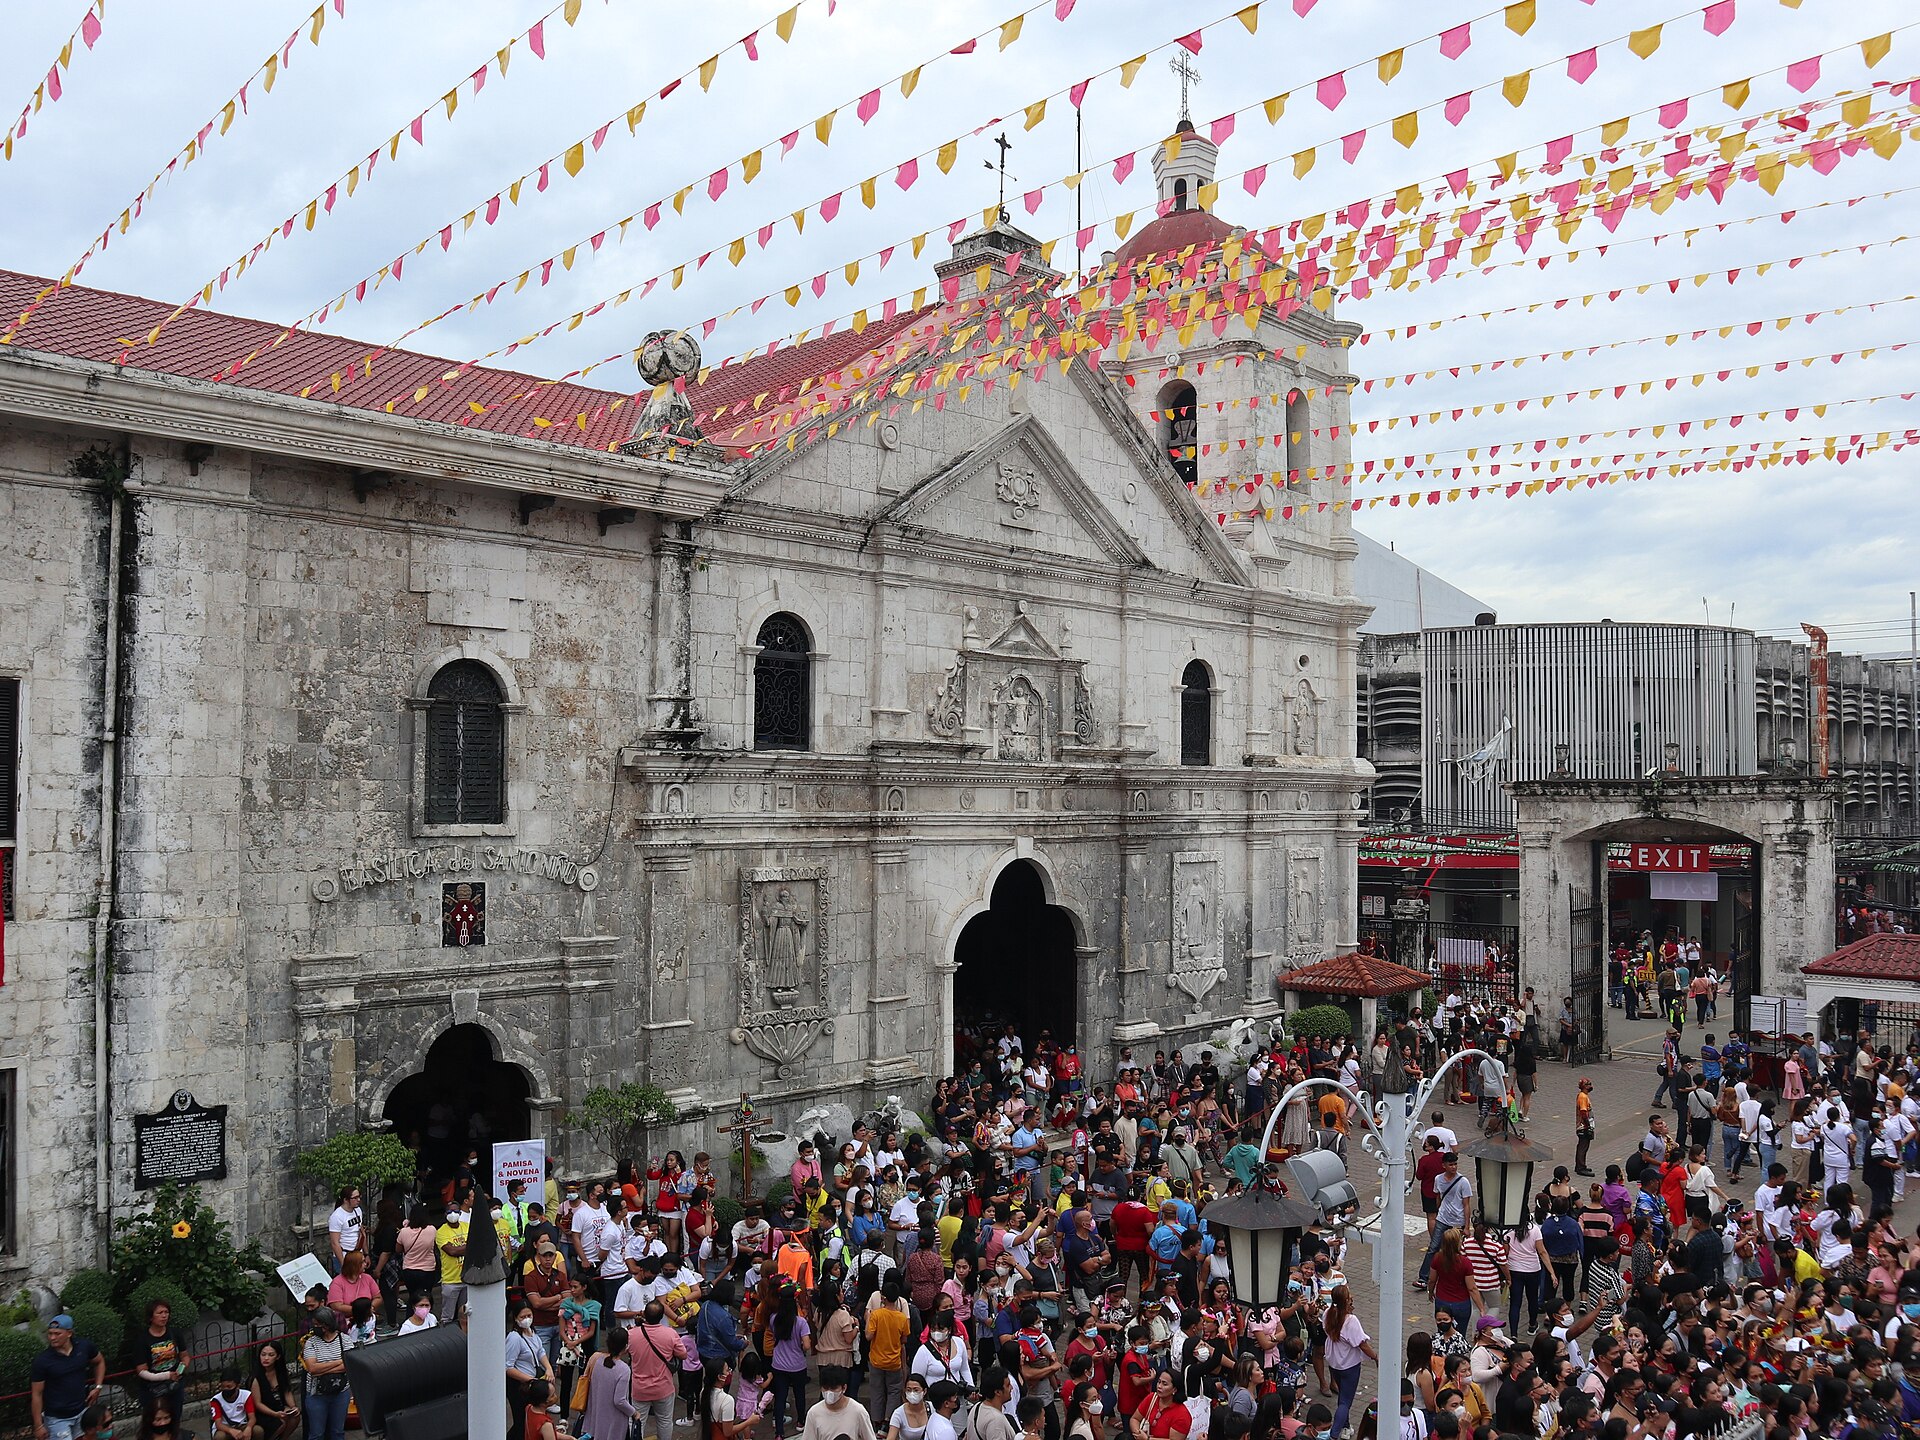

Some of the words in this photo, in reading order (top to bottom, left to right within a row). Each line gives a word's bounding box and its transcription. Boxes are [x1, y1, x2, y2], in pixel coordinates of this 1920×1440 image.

[1638, 848, 1701, 868] EXIT
[339, 848, 436, 893] BASILICA
[448, 845, 477, 872] del
[1640, 972, 1654, 980] EXIT
[502, 1160, 533, 1168] PAMISA
[507, 1168, 539, 1176] NOVENA
[499, 1177, 538, 1186] SPSOR
